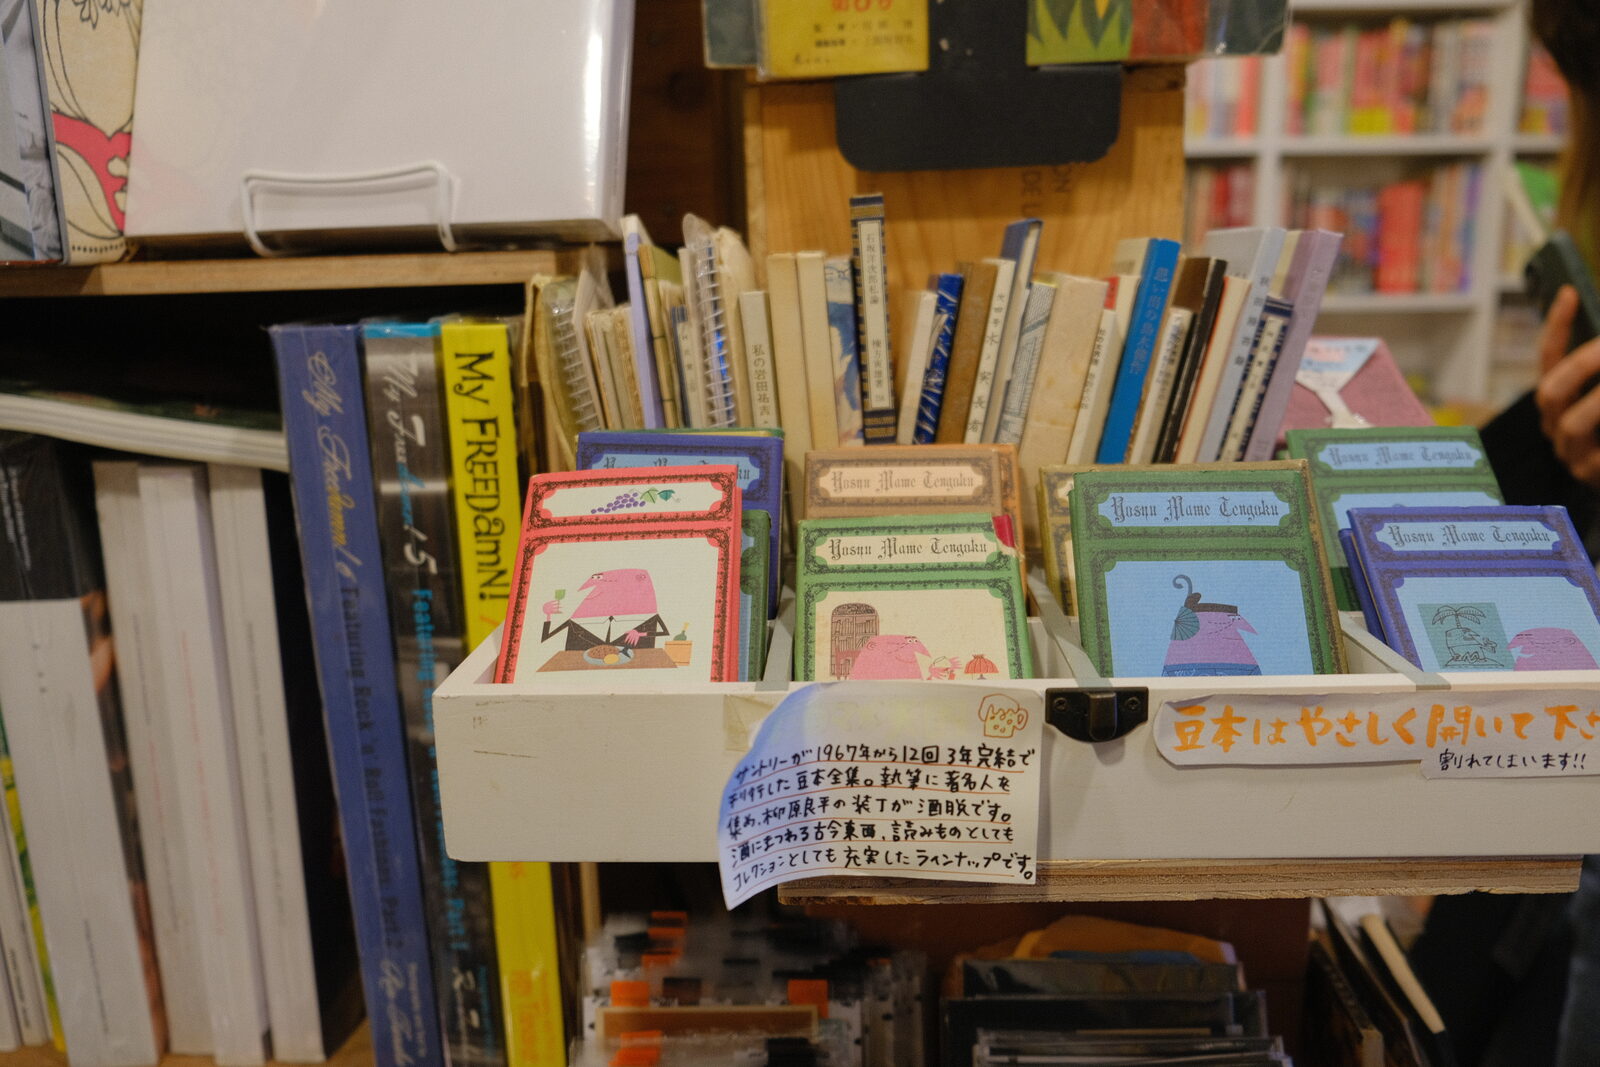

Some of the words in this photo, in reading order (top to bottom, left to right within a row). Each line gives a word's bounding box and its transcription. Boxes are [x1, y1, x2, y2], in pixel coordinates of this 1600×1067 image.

[453, 351, 495, 405] My
[403, 542, 439, 575] 5
[411, 589, 438, 681] Featuring
